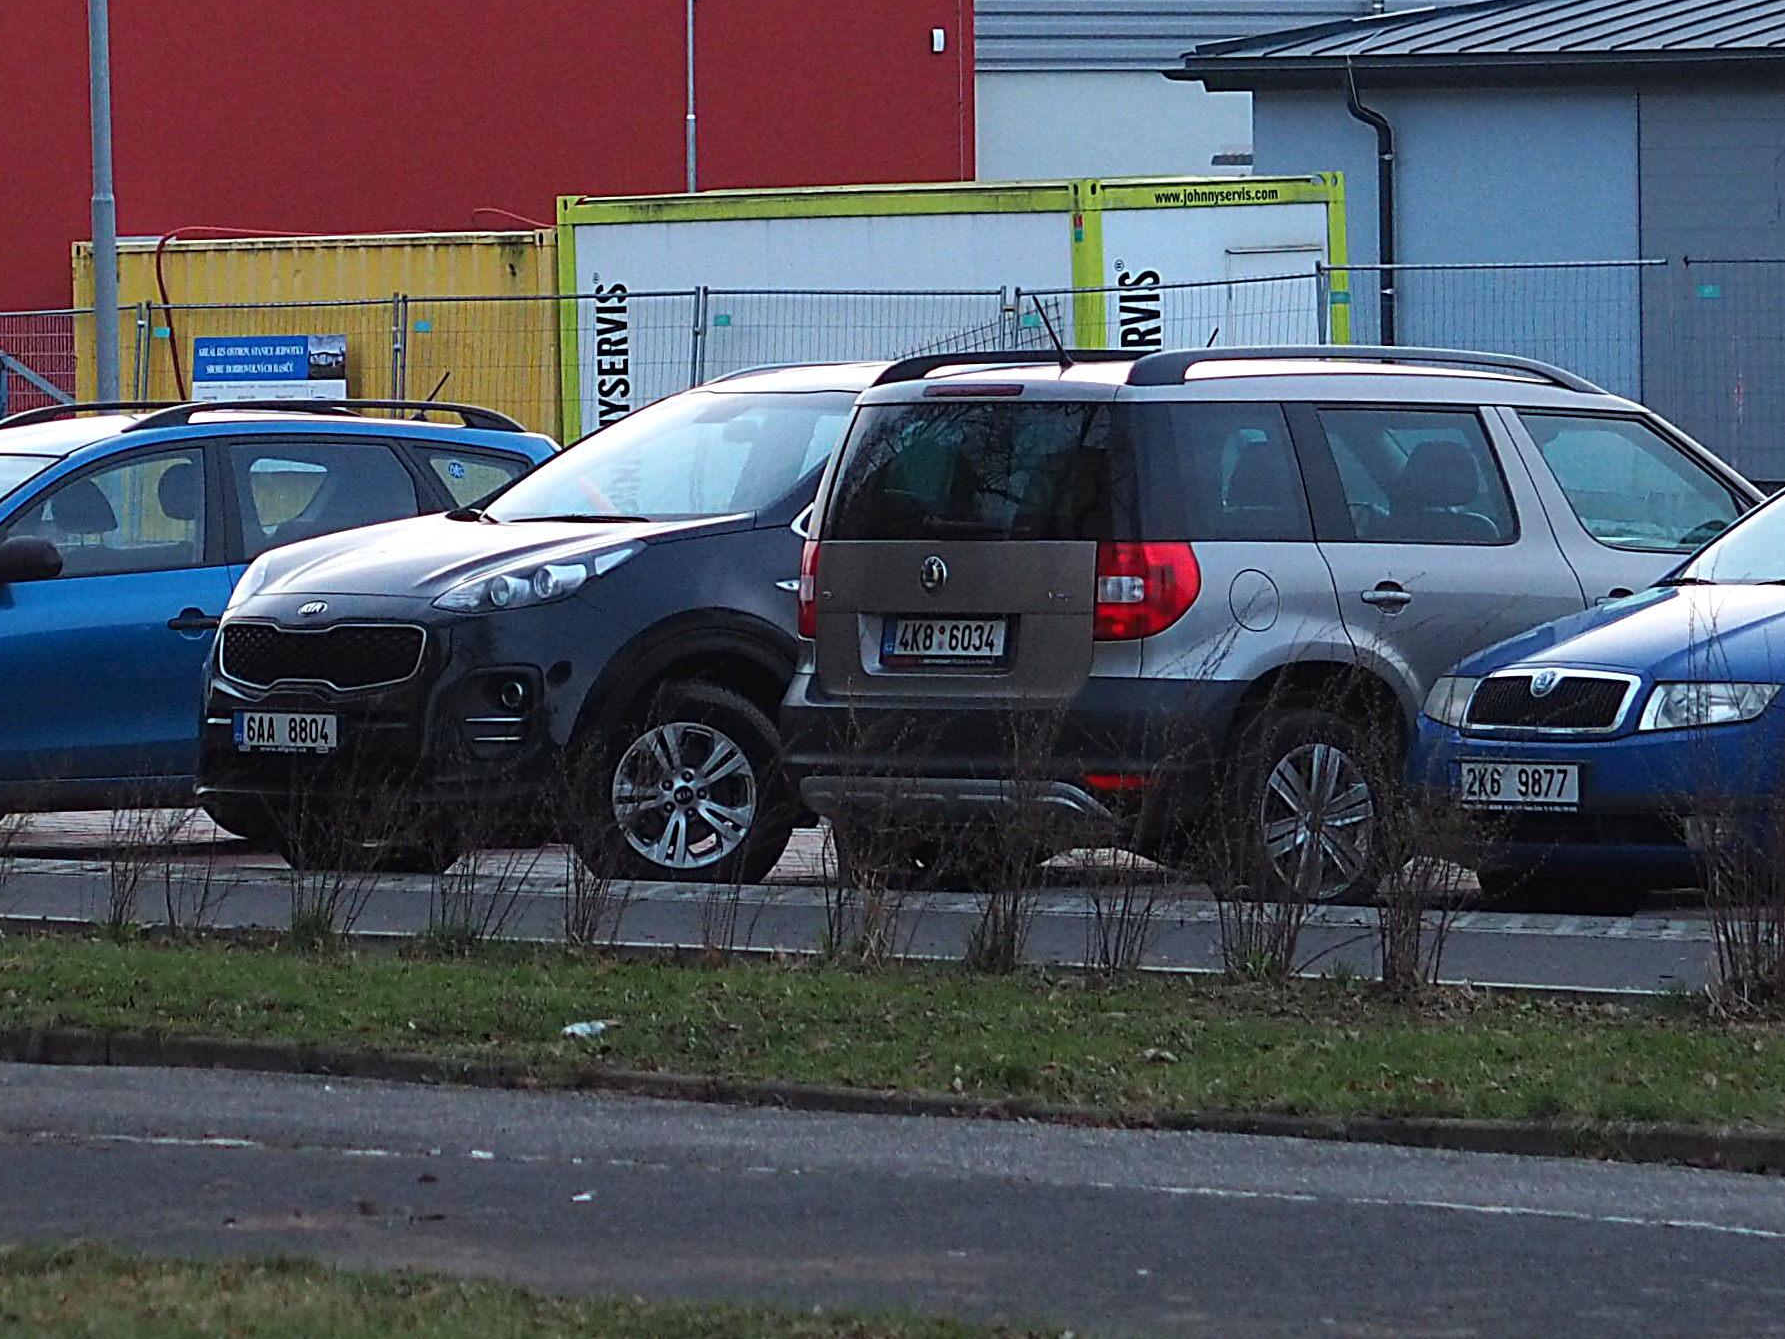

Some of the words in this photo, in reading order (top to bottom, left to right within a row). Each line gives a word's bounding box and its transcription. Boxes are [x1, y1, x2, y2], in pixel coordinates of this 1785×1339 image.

[1154, 187, 1279, 206] www.johnnyservis.com
[899, 623, 934, 651] 4K8
[949, 624, 995, 652] 6034
[247, 716, 275, 743] 6AA
[289, 717, 329, 744] 8804
[1466, 768, 1503, 798] 2K6
[1518, 768, 1568, 798] 9877
